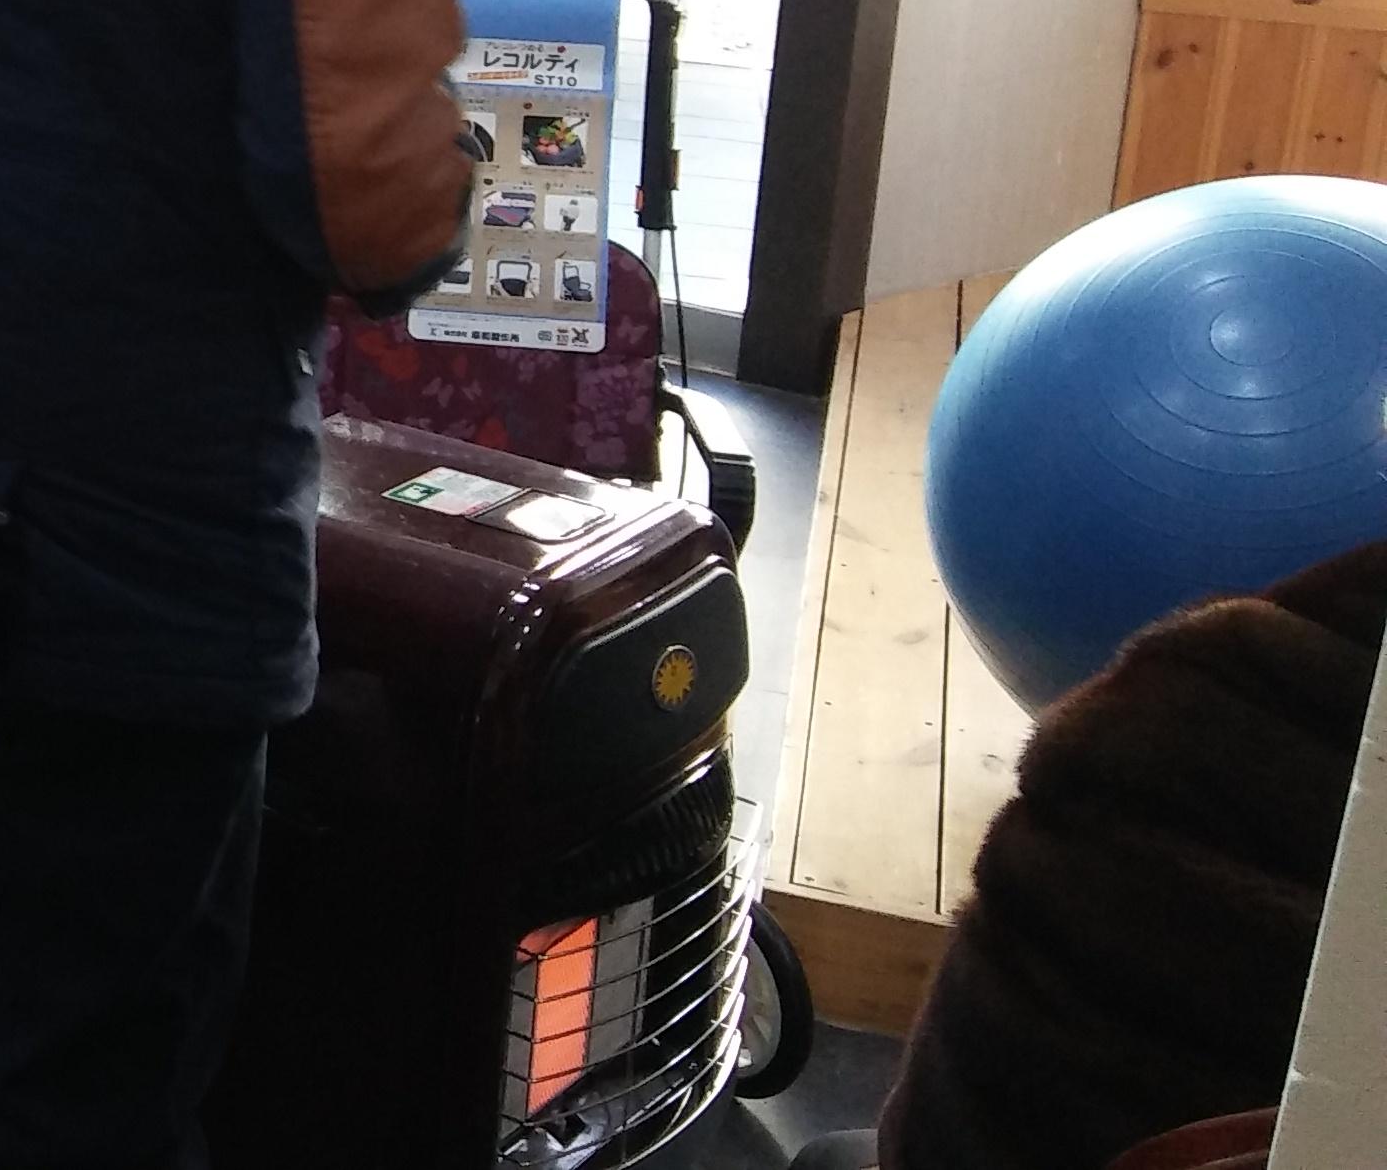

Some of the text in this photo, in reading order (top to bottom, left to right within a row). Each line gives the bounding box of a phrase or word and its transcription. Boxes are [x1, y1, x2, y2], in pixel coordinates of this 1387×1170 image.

[483, 50, 580, 74] レコルティ
[534, 74, 578, 88] ST10
